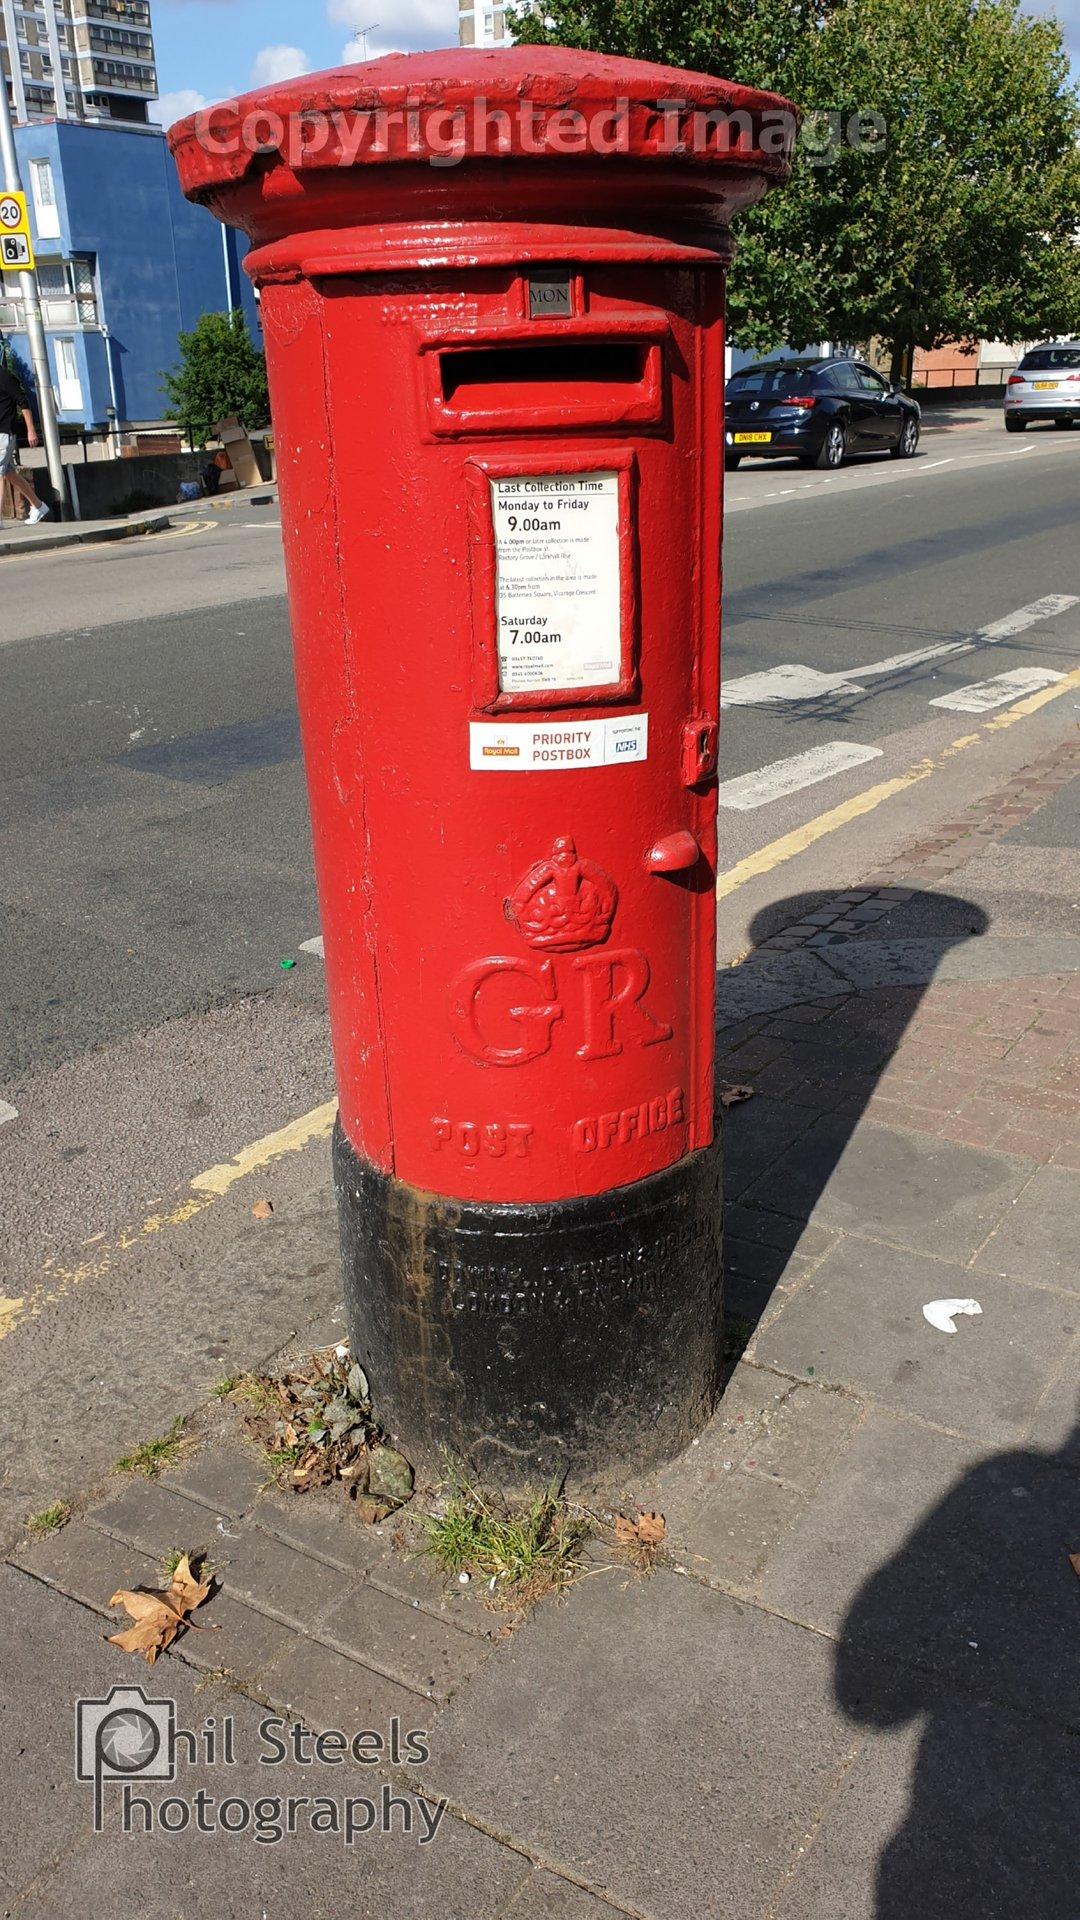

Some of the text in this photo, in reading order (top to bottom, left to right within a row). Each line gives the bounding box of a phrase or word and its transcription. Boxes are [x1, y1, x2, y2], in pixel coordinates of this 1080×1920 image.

[1, 206, 19, 219] 20
[530, 288, 569, 302] MON
[498, 480, 604, 494] Last Collection Time
[498, 499, 590, 512] Monday to Friday
[507, 516, 561, 532] 9.00am
[500, 615, 548, 627] Saturday
[509, 629, 562, 645] 7.00am
[532, 731, 592, 746] PRIORITY
[484, 747, 518, 756] Royal Mail
[617, 740, 637, 752] NHS
[533, 748, 591, 762] POSTBOX
[451, 948, 674, 1068] GR
[431, 1086, 686, 1158] POST OFFICE
